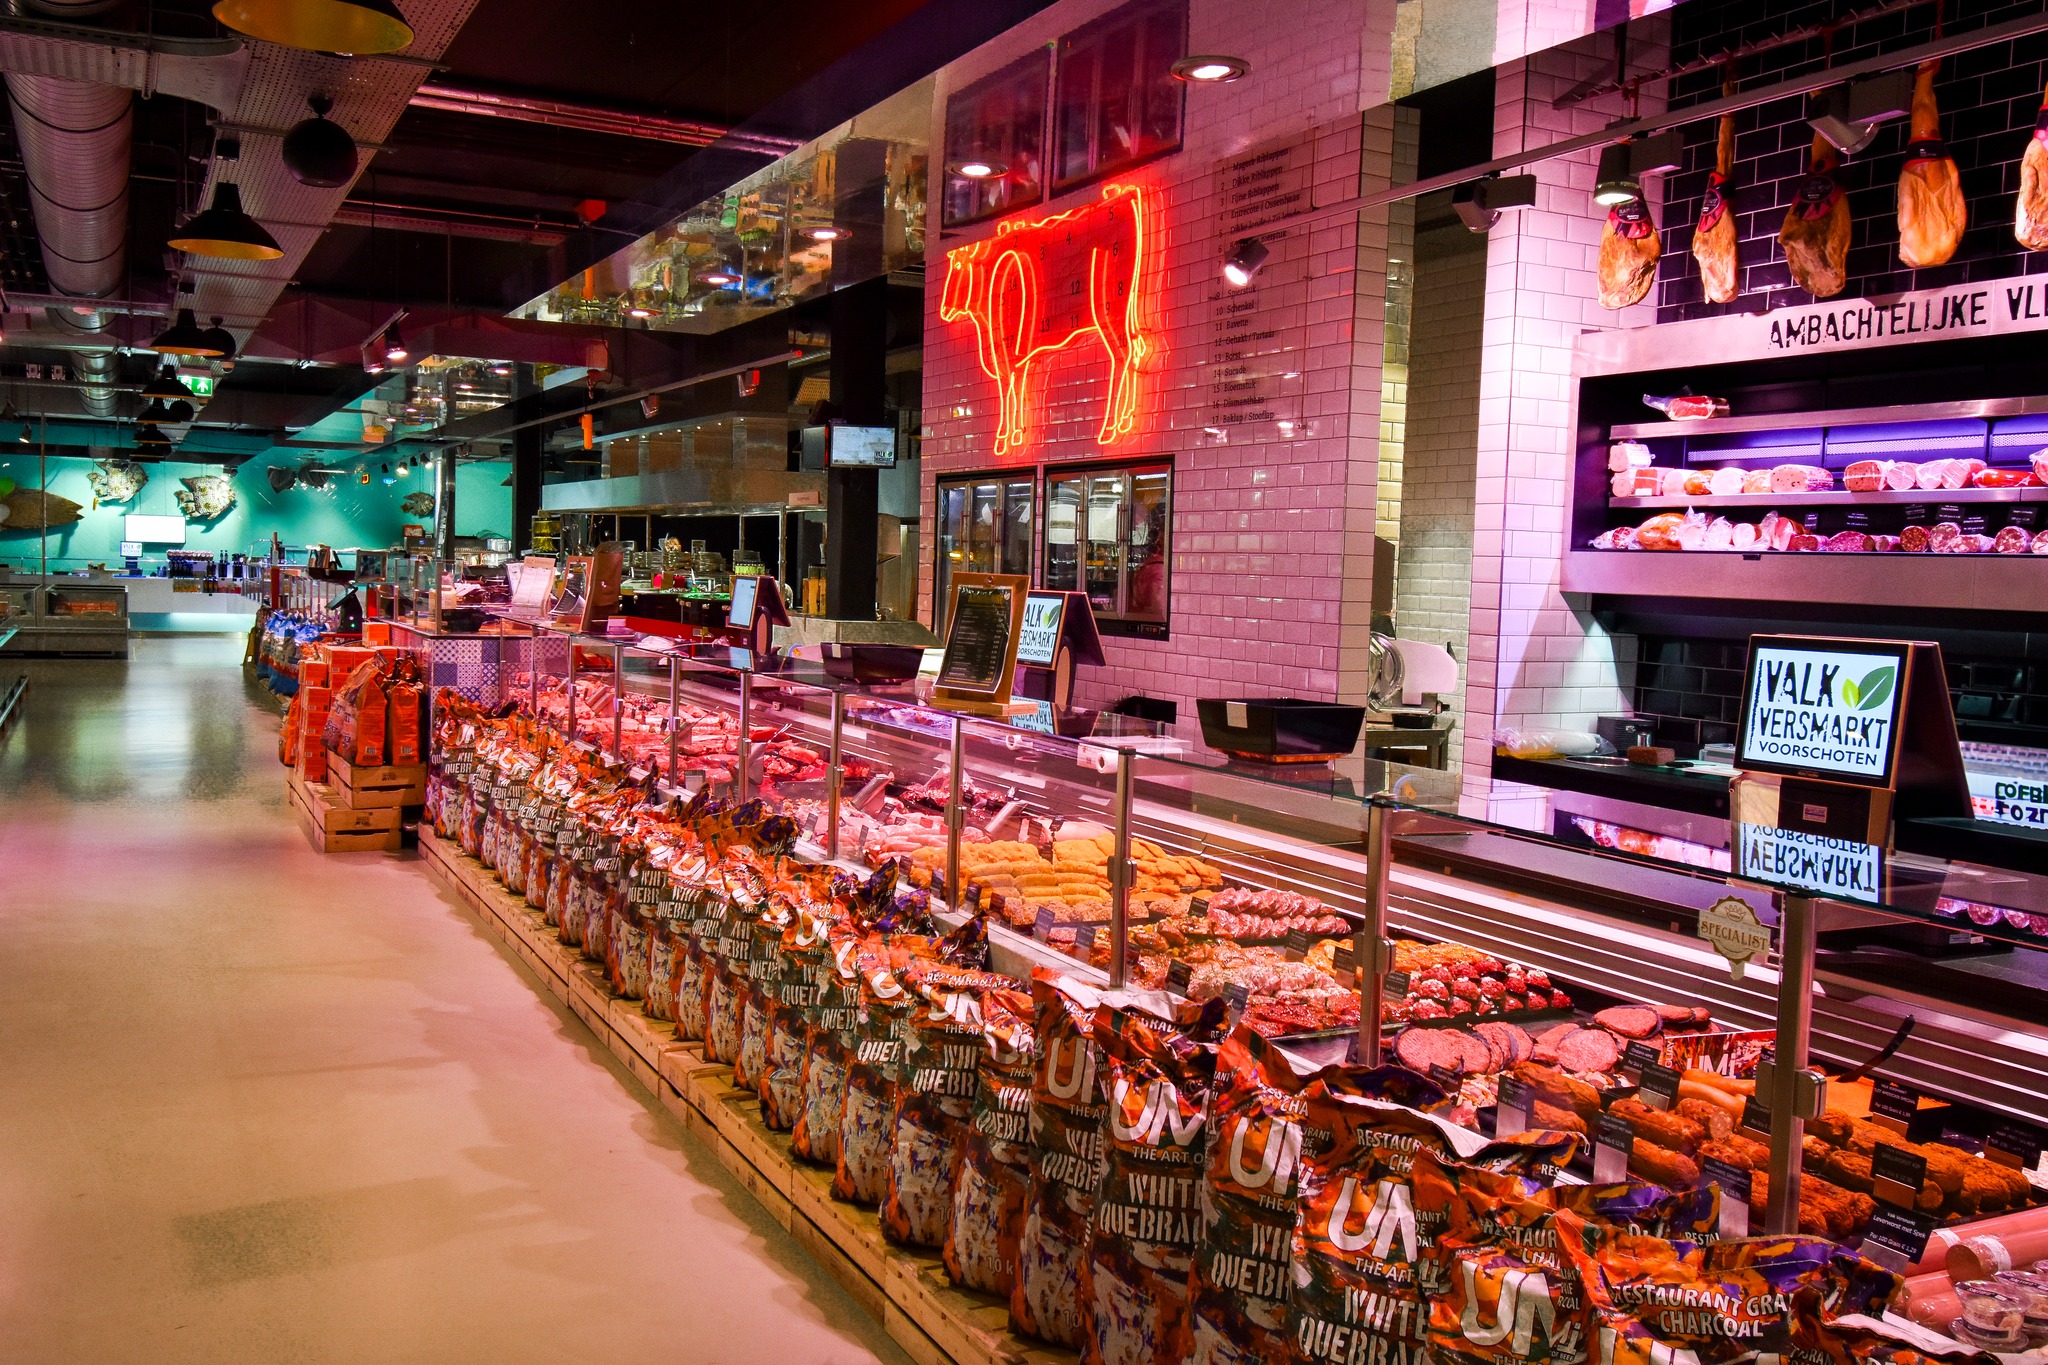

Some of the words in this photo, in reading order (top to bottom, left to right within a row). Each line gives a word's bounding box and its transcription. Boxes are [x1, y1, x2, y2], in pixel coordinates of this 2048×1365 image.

[1221, 182, 1225, 191] 2
[1233, 176, 1250, 188] Dikke
[1251, 166, 1283, 181] Riblappen
[1220, 198, 1224, 207] 3
[1248, 183, 1279, 198] Riblappen
[1219, 214, 1224, 222] 4
[1231, 204, 1259, 219] Entrecote
[1265, 193, 1300, 210] Ossenhaas
[1014, 235, 1018, 248] 2
[1066, 232, 1071, 245] 4
[1040, 246, 1045, 260] 3
[1113, 242, 1118, 256] 6
[1218, 261, 1222, 269] 7
[1070, 280, 1080, 295] 12
[1118, 281, 1123, 296] 8
[1217, 277, 1221, 285] 8
[1105, 301, 1110, 315] 9
[1216, 306, 1223, 315] 10
[1227, 299, 1254, 313] Schenkel
[1041, 319, 1050, 333] 13
[1070, 314, 1079, 330] 11
[1216, 323, 1222, 331] 11
[1226, 319, 1248, 330] Bavette
[1768, 292, 1988, 349] AMBACHTELIJKE
[1215, 338, 1222, 347] 12
[1214, 354, 1221, 362] 13
[1225, 352, 1241, 361] Borst
[1214, 369, 1220, 378] 14
[1225, 365, 1246, 377] Sucade
[1213, 385, 1220, 393] 15
[1224, 380, 1256, 392] Bloemstuk
[1213, 400, 1220, 409] 16
[1212, 416, 1219, 424] 17
[1223, 413, 1243, 424] Baklap
[1248, 410, 1274, 422] Stooflap
[1024, 603, 1044, 628] ALK
[1020, 629, 1056, 648] ERSMARKT
[1018, 648, 1051, 657] OORSCHOTEN
[1766, 660, 1840, 708] VALK
[1759, 708, 1887, 749] VERSMARKT
[1759, 741, 1877, 766] VOORSCHOTEN
[1701, 920, 1768, 950] SPECIALIST
[945, 1024, 963, 1034] THE
[1665, 1040, 1675, 1068] GUAY
[1069, 1104, 1089, 1116] THE
[1132, 1146, 1157, 1161] THE
[1161, 1148, 1188, 1163] ART
[1259, 1194, 1283, 1212] THE
[1873, 1214, 1902, 1229] Leverworst
[1901, 1226, 1913, 1234] met
[1912, 1229, 1926, 1239] Spek
[1869, 1231, 1878, 1239] Per
[1355, 1256, 1383, 1275] THE
[1612, 1283, 1741, 1316] RESTAURANT
[1344, 1285, 1429, 1340] WHITE
[1659, 1310, 1763, 1338] CHARCOAL
[1560, 1352, 1574, 1361] BEEF
